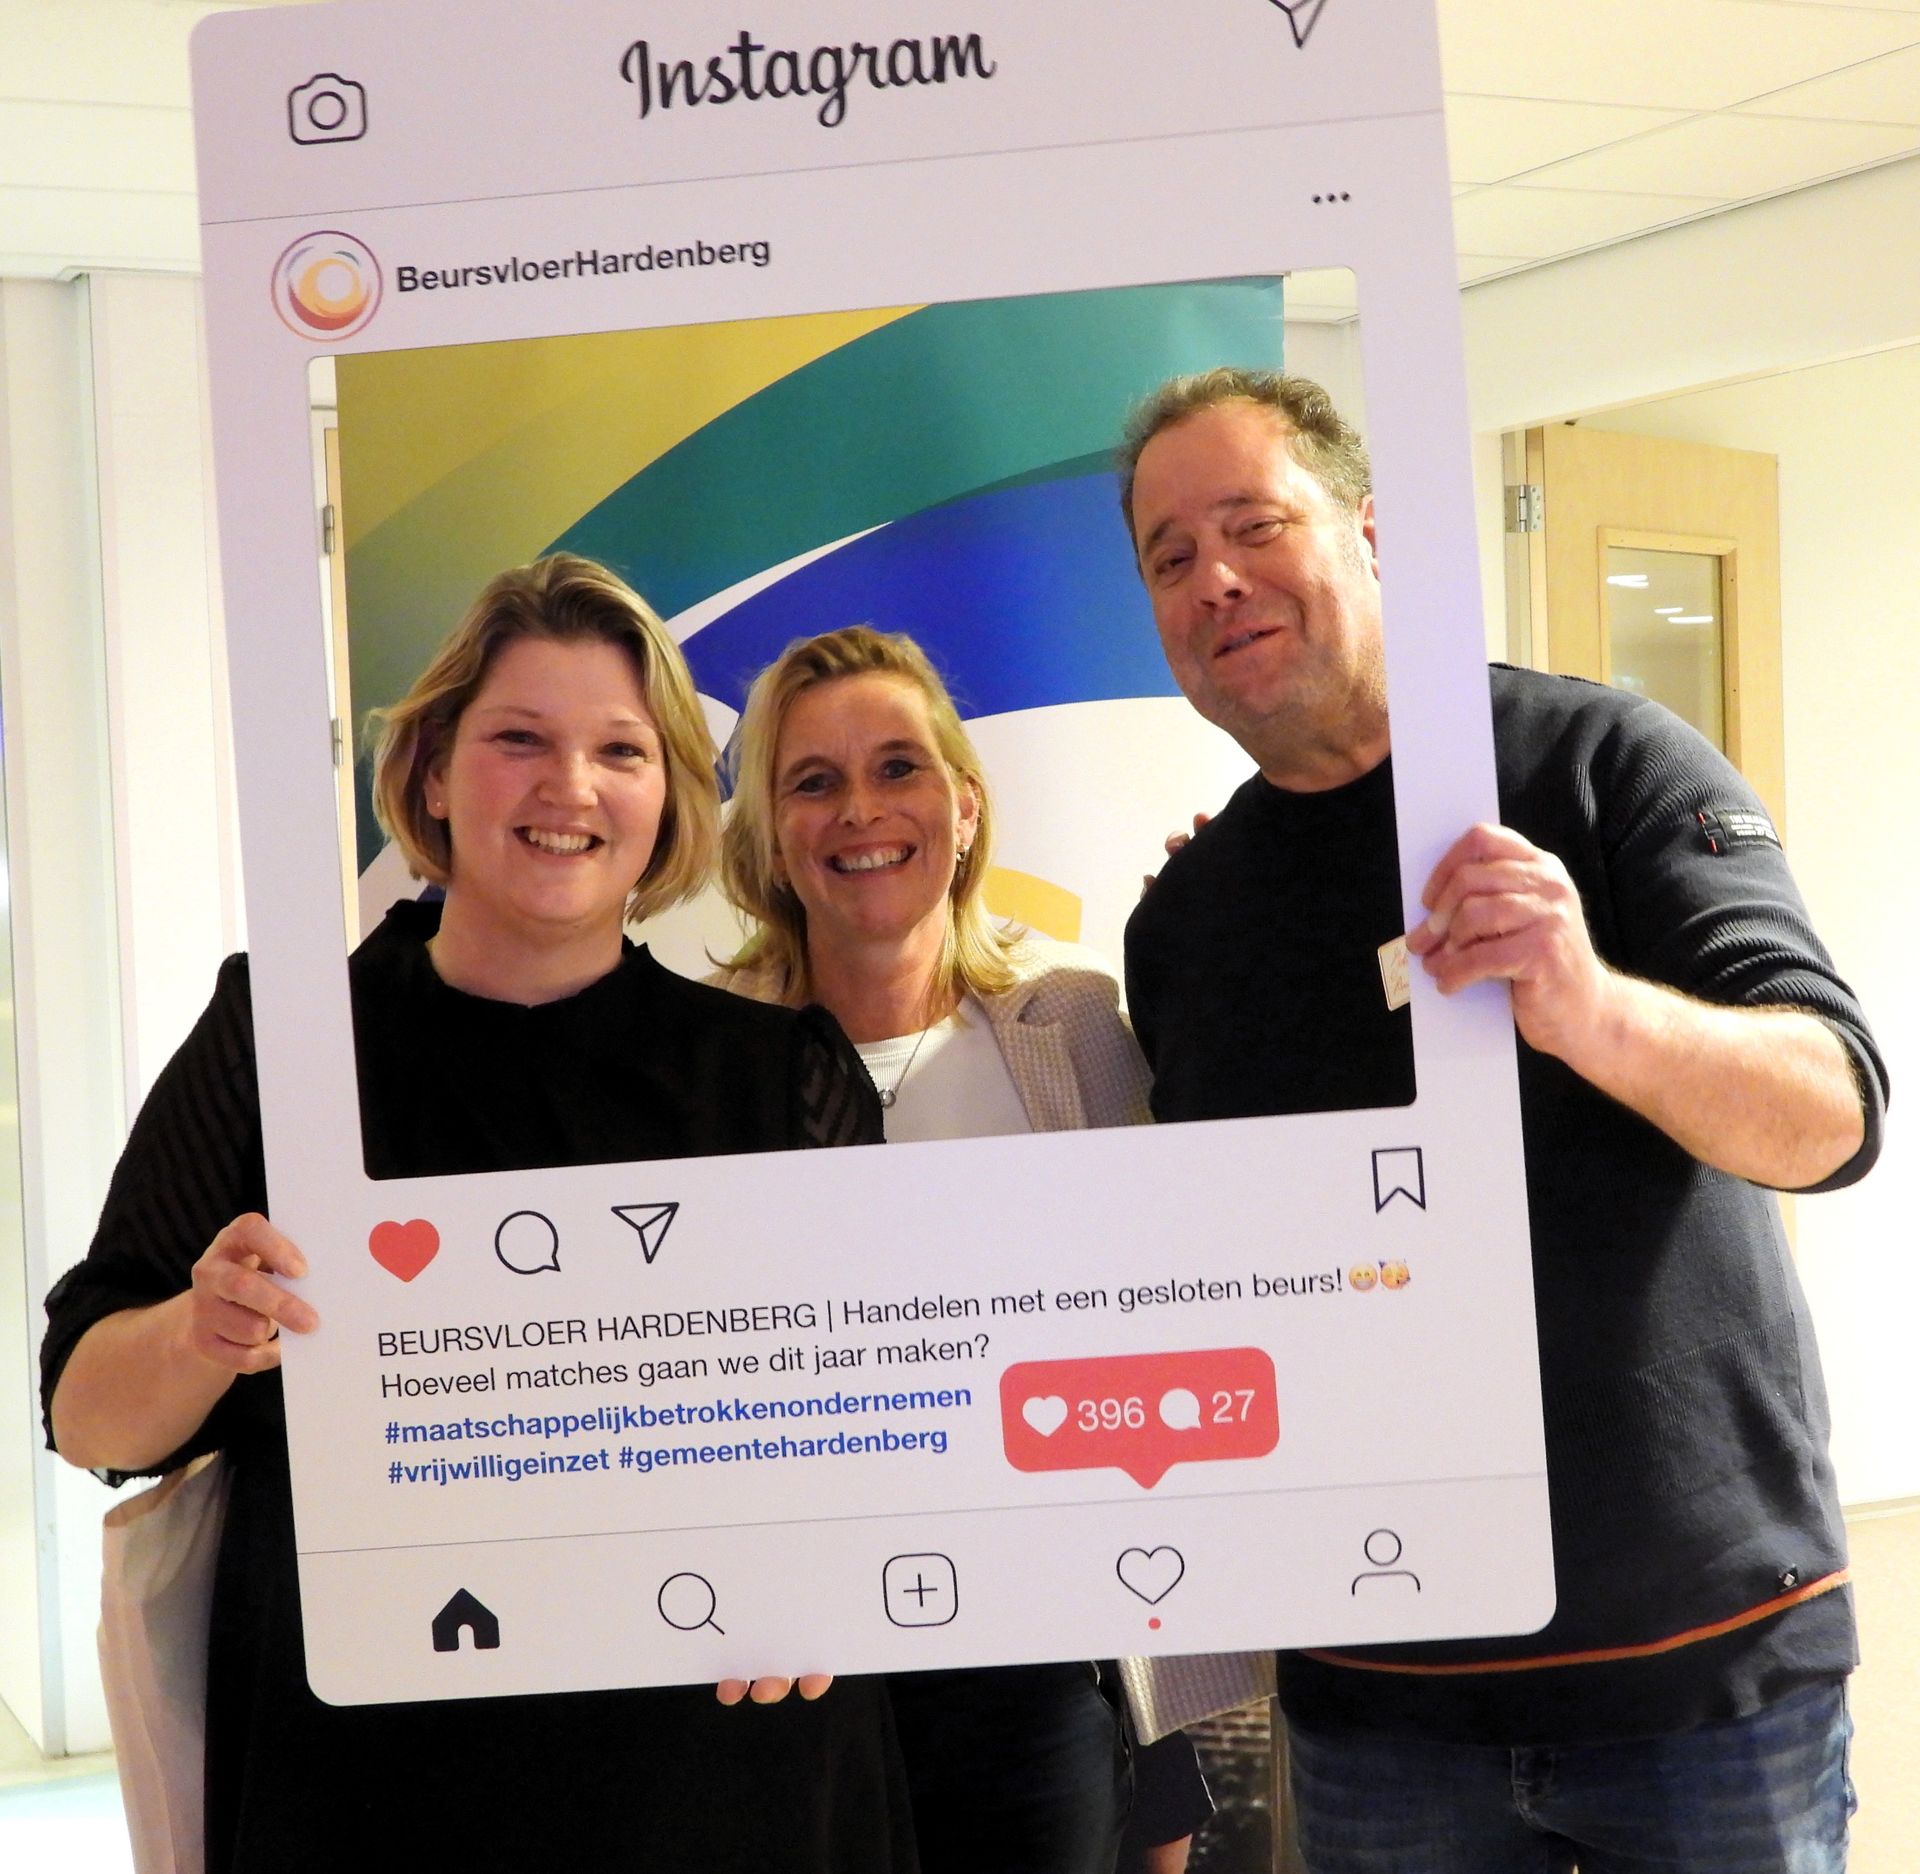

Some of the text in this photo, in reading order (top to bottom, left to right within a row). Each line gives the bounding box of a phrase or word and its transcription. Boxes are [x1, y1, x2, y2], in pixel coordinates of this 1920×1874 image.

[619, 31, 997, 127] Instagram
[396, 238, 772, 293] BeursvloerHardenberg
[377, 1319, 588, 1357] BEURSVLOER
[598, 1303, 817, 1342] HARDENBERG
[843, 1293, 981, 1326] Handelen
[990, 1288, 1046, 1315] met
[1056, 1288, 1108, 1311] een
[1118, 1277, 1243, 1312] gesloten
[1252, 1267, 1344, 1297] beurs!
[381, 1333, 990, 1398] Hoeveel matches gaan we dit jaar maken?
[384, 1386, 973, 1446] #maatschappelijkbetrokkenondernemen
[1077, 1389, 1256, 1432] 396 27
[388, 1428, 949, 1487] #vrijwilligeinzet #gemeentehardenberg
